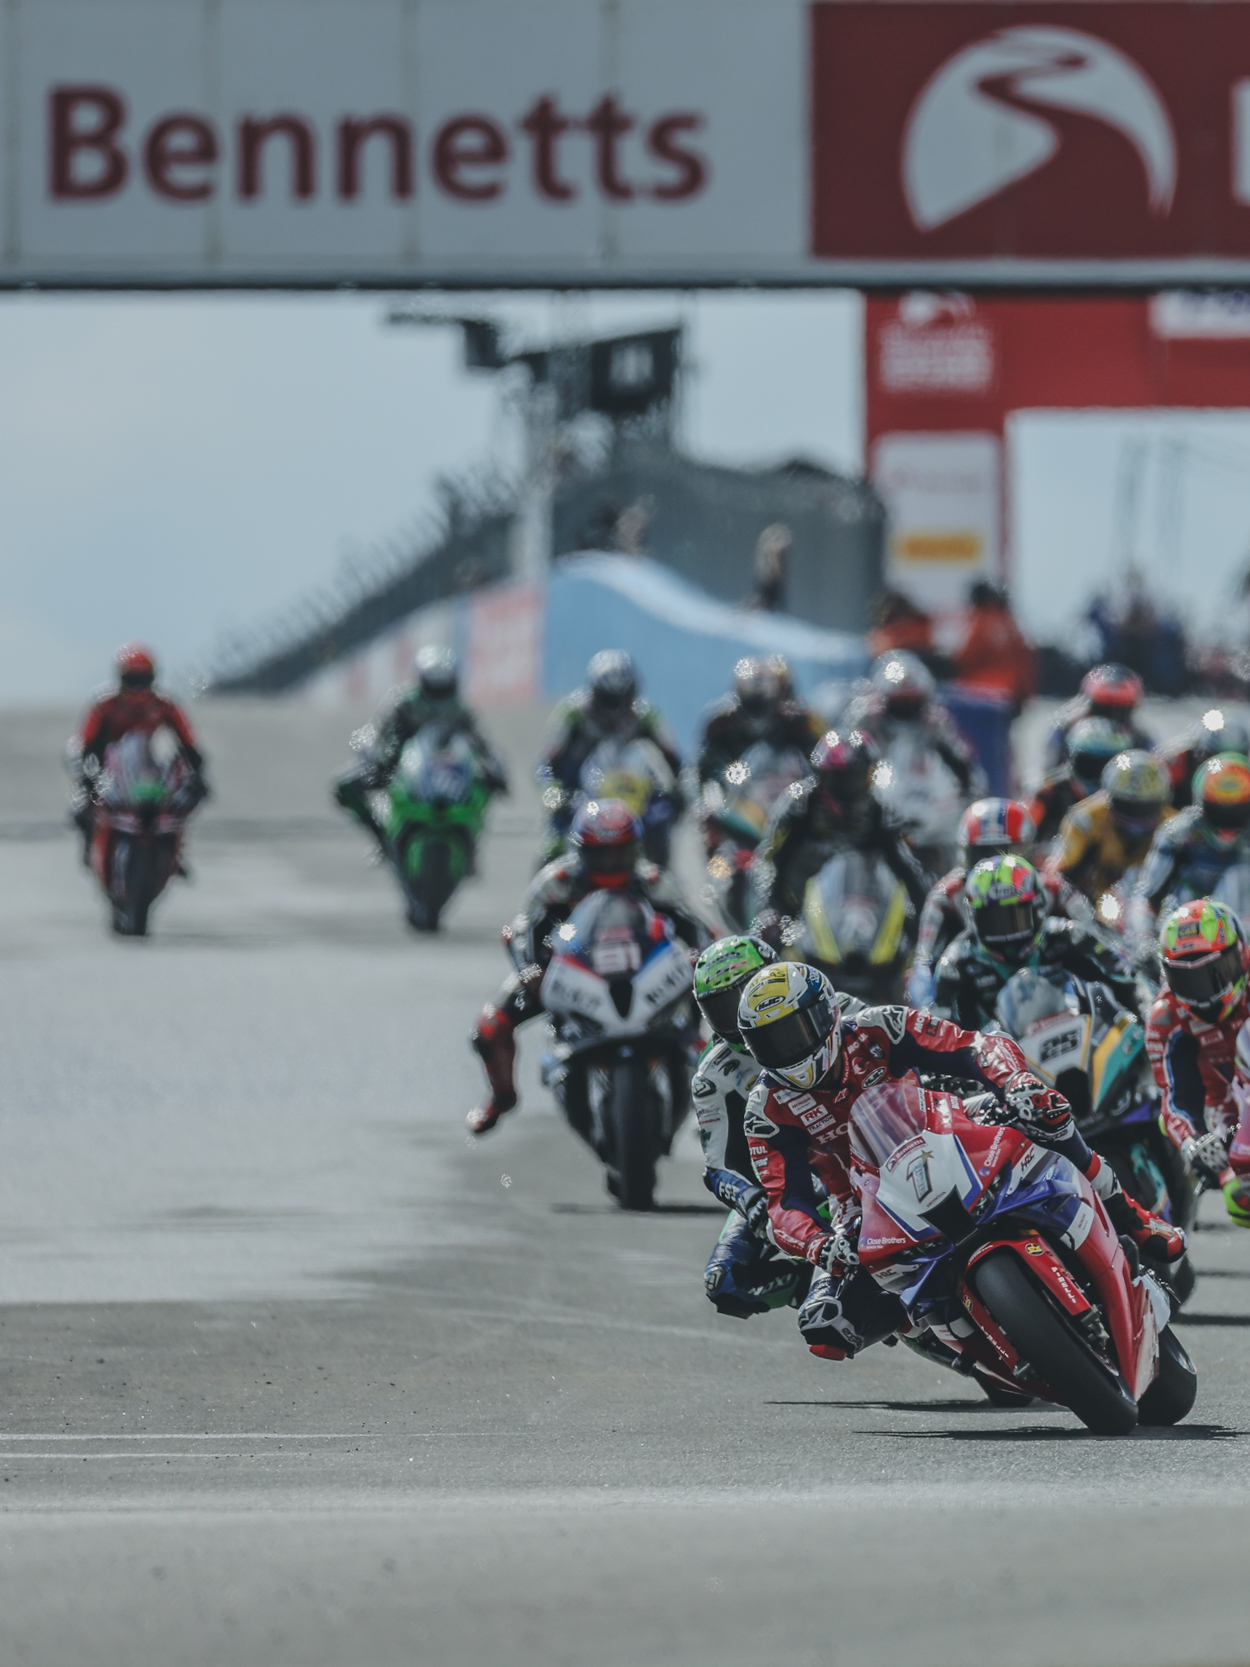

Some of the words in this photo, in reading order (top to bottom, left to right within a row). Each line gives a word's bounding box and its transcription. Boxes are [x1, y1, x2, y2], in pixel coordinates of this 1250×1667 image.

[48, 84, 711, 203] Bennetts
[750, 969, 786, 988] ATAS
[757, 996, 784, 1012] HJC
[847, 1033, 869, 1054] MOUL
[1040, 1029, 1078, 1063] 25
[804, 1107, 823, 1121] RK
[808, 1115, 834, 1132] TRACTION
[896, 1138, 924, 1160] Bennetts
[989, 1126, 1005, 1152] Brothers
[749, 1145, 768, 1156] OTUL
[984, 1146, 995, 1167] Close
[1020, 1147, 1035, 1172] HRC
[906, 1153, 933, 1204] 1
[867, 1237, 881, 1245] Close
[881, 1236, 906, 1244] Brothers
[876, 1268, 897, 1279] HRC
[1051, 1266, 1077, 1304] PIRELLI
